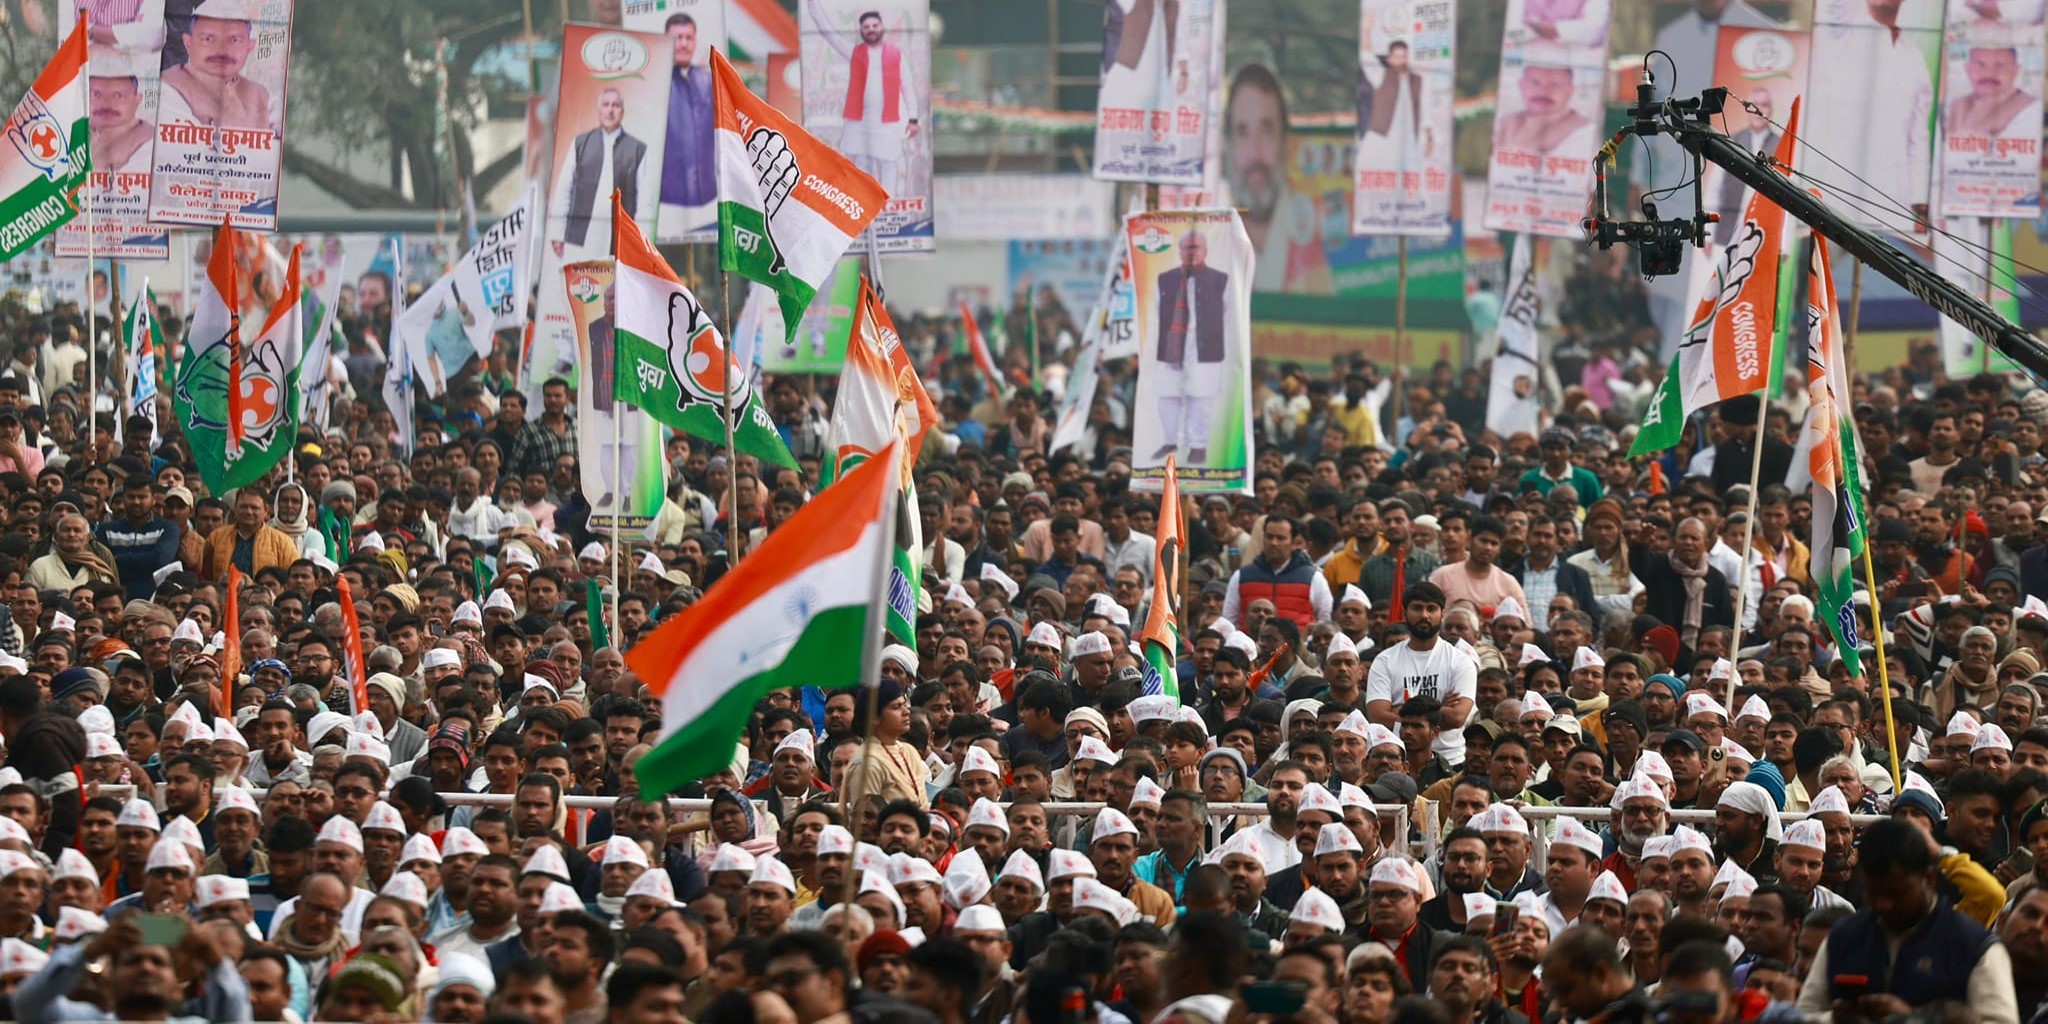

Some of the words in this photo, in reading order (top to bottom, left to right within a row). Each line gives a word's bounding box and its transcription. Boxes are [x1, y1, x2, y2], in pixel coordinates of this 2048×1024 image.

[160, 118, 214, 146] संतोष
[221, 128, 273, 155] कुमार
[183, 151, 201, 165] पूर्व
[803, 174, 865, 220] CONGRESS
[1731, 301, 1760, 380] CONGRESS
[636, 357, 666, 393] युवा
